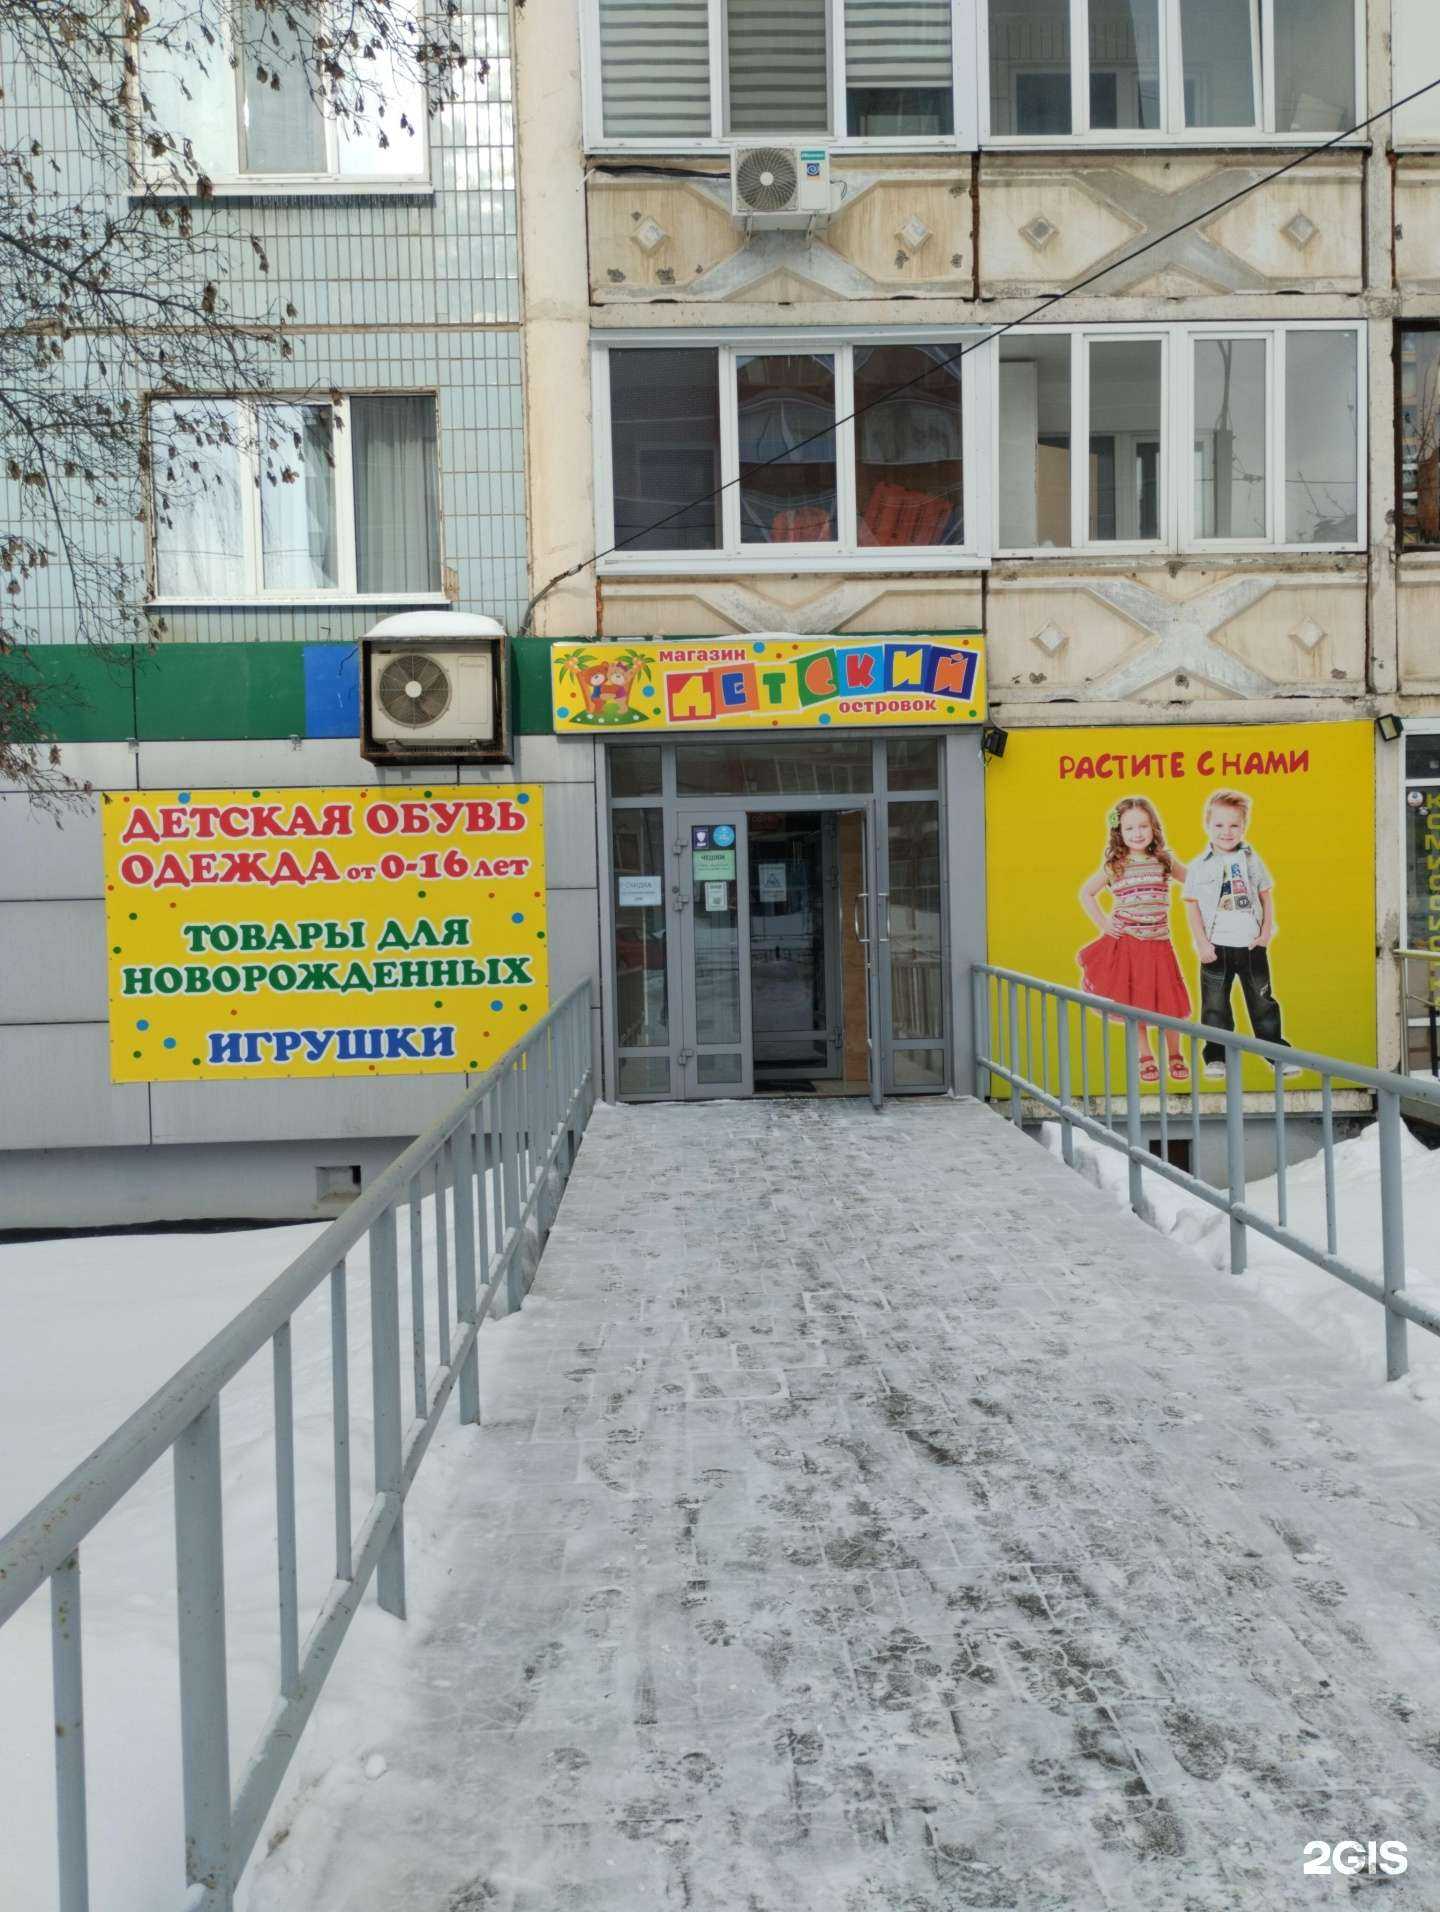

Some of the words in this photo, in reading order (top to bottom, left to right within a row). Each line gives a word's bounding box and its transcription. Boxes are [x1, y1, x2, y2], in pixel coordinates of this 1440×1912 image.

[659, 649, 746, 662] магазин
[671, 649, 968, 717] ДЕТСКИЙ
[838, 699, 937, 715] островок
[1059, 752, 1185, 780] РАСТИТЕ
[1196, 751, 1215, 776] С
[1222, 750, 1309, 776] НАМИ
[122, 805, 353, 844] ДЕТСКАЯ
[366, 801, 526, 835] ОБУВЬ
[121, 851, 341, 888] ОДЕЖДА
[346, 867, 376, 880] от
[380, 850, 469, 879] 0-16
[473, 859, 530, 877] лет
[183, 921, 366, 952] ТОВАРЫ
[377, 919, 470, 951] ДЛЯ
[123, 957, 533, 995] НОВОРОЖДЕННЫХ
[208, 1026, 455, 1064] ИГРУШКИ
